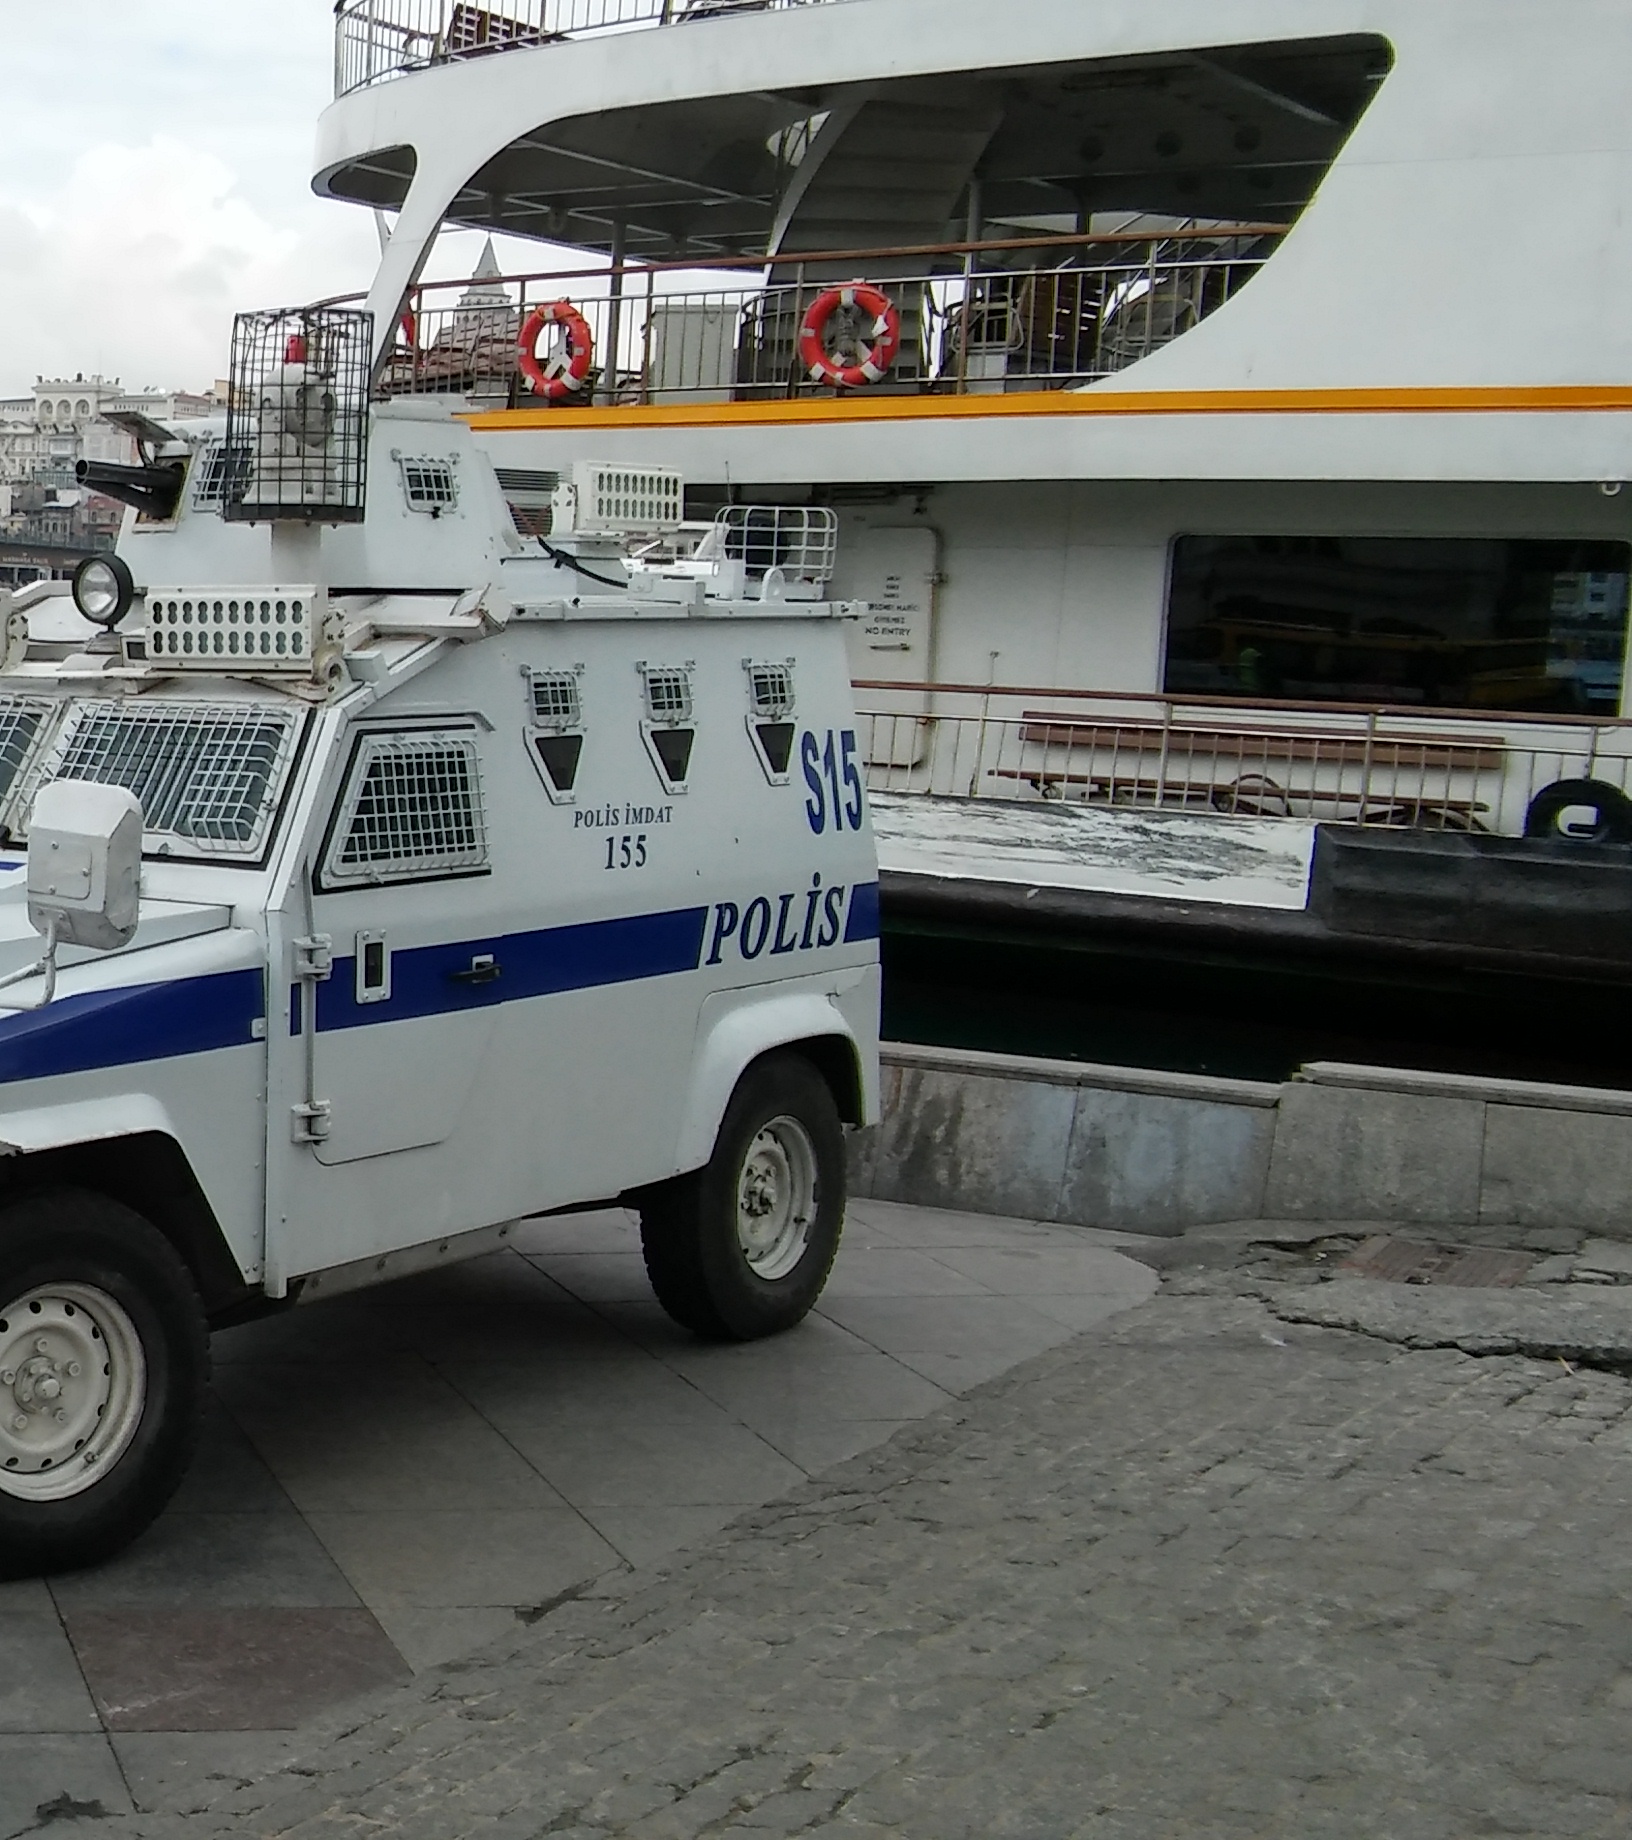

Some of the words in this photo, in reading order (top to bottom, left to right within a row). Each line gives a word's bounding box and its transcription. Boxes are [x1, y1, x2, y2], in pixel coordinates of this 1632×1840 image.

[801, 729, 863, 835] S15
[573, 803, 620, 829] POLİS
[624, 802, 674, 827] İMDAT
[604, 834, 647, 870] 155
[704, 871, 845, 967] POLİS
